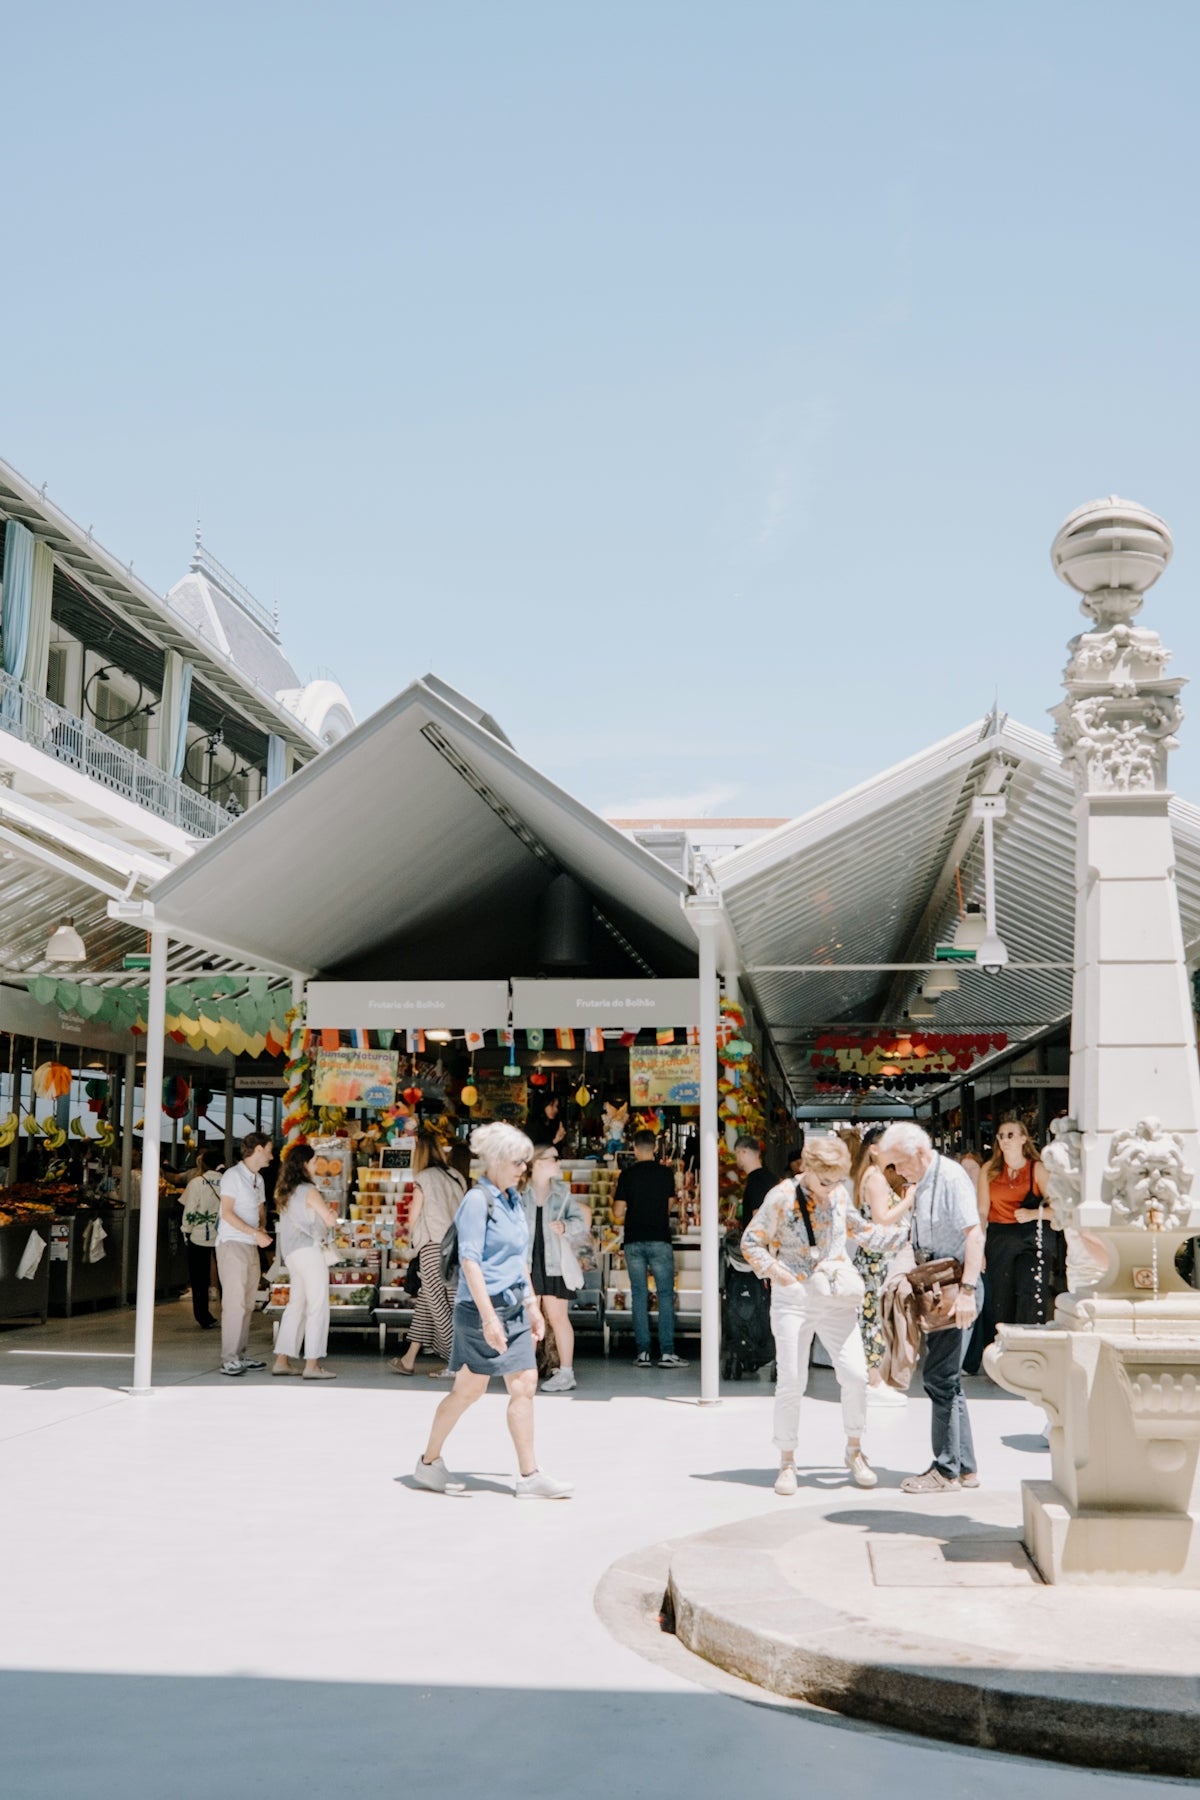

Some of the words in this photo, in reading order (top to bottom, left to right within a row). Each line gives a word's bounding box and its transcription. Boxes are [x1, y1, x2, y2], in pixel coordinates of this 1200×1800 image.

[368, 999, 402, 1009] Frutaria
[576, 998, 610, 1008] Frutaria
[612, 998, 624, 1008] do
[625, 997, 656, 1008] Bolhão
[685, 1046, 701, 1054] Fru
